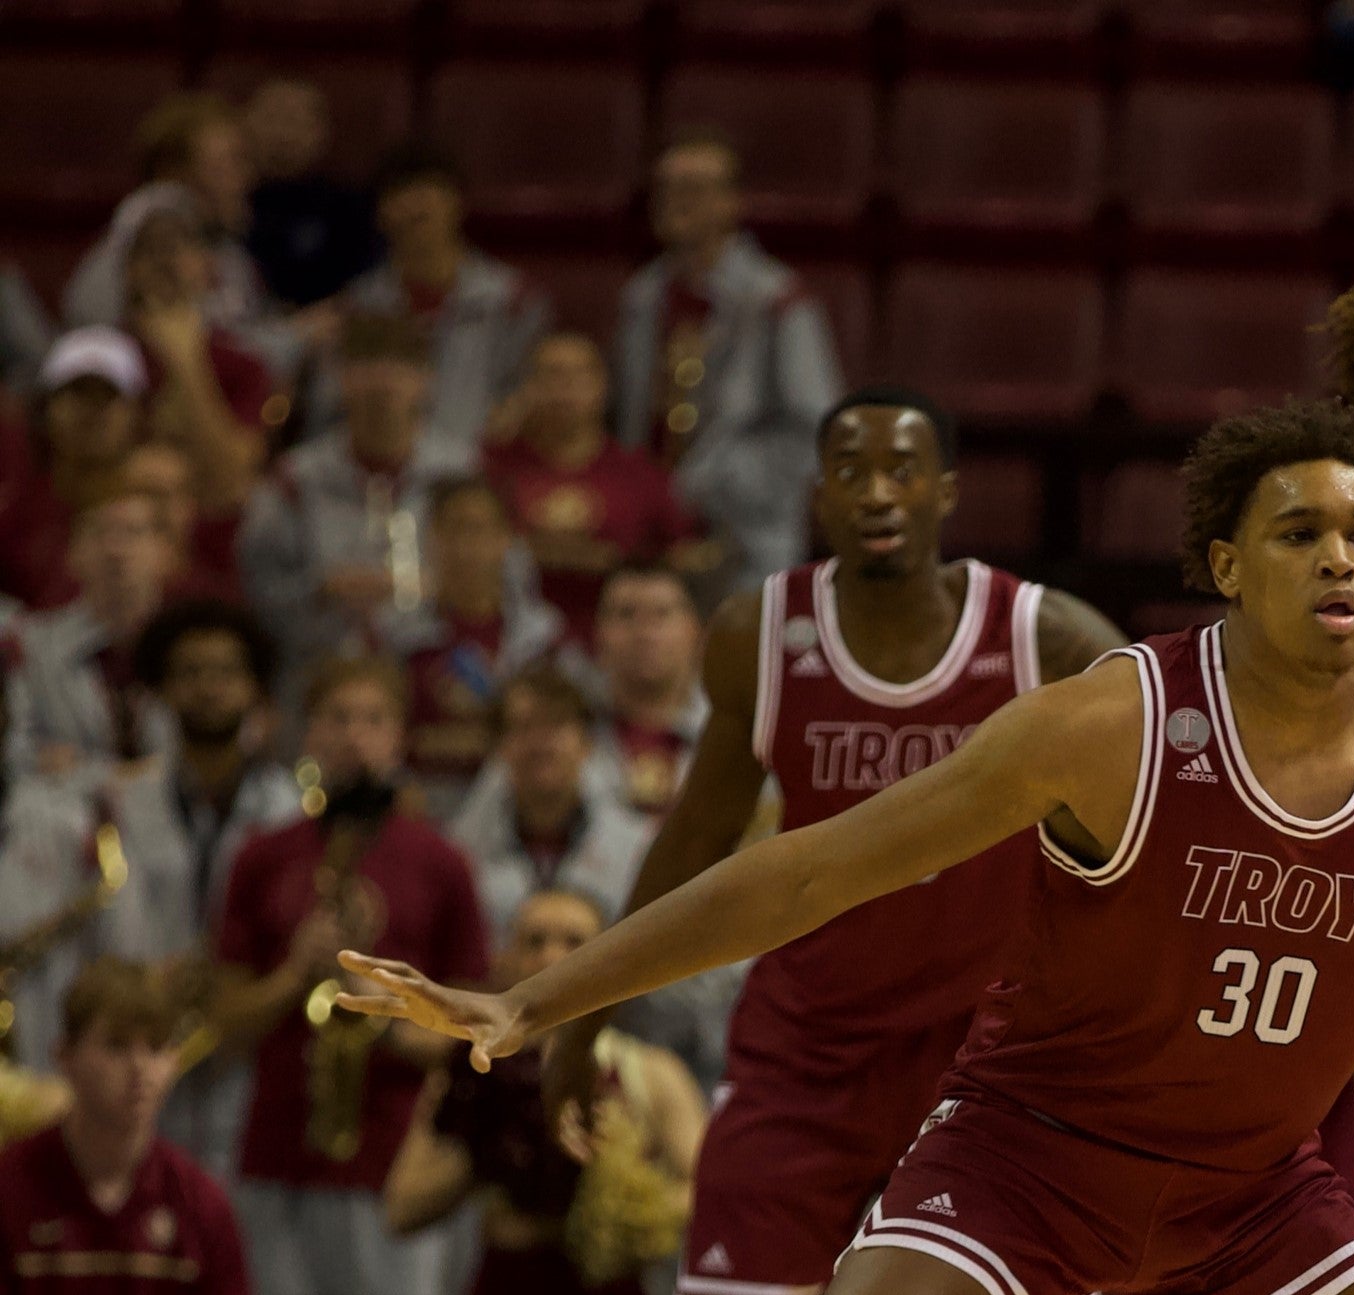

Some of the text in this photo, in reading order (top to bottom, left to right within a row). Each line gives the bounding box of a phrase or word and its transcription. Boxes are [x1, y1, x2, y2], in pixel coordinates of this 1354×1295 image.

[1176, 769, 1219, 784] adidas
[1196, 947, 1319, 1045] 30
[916, 1201, 958, 1218] adidas
